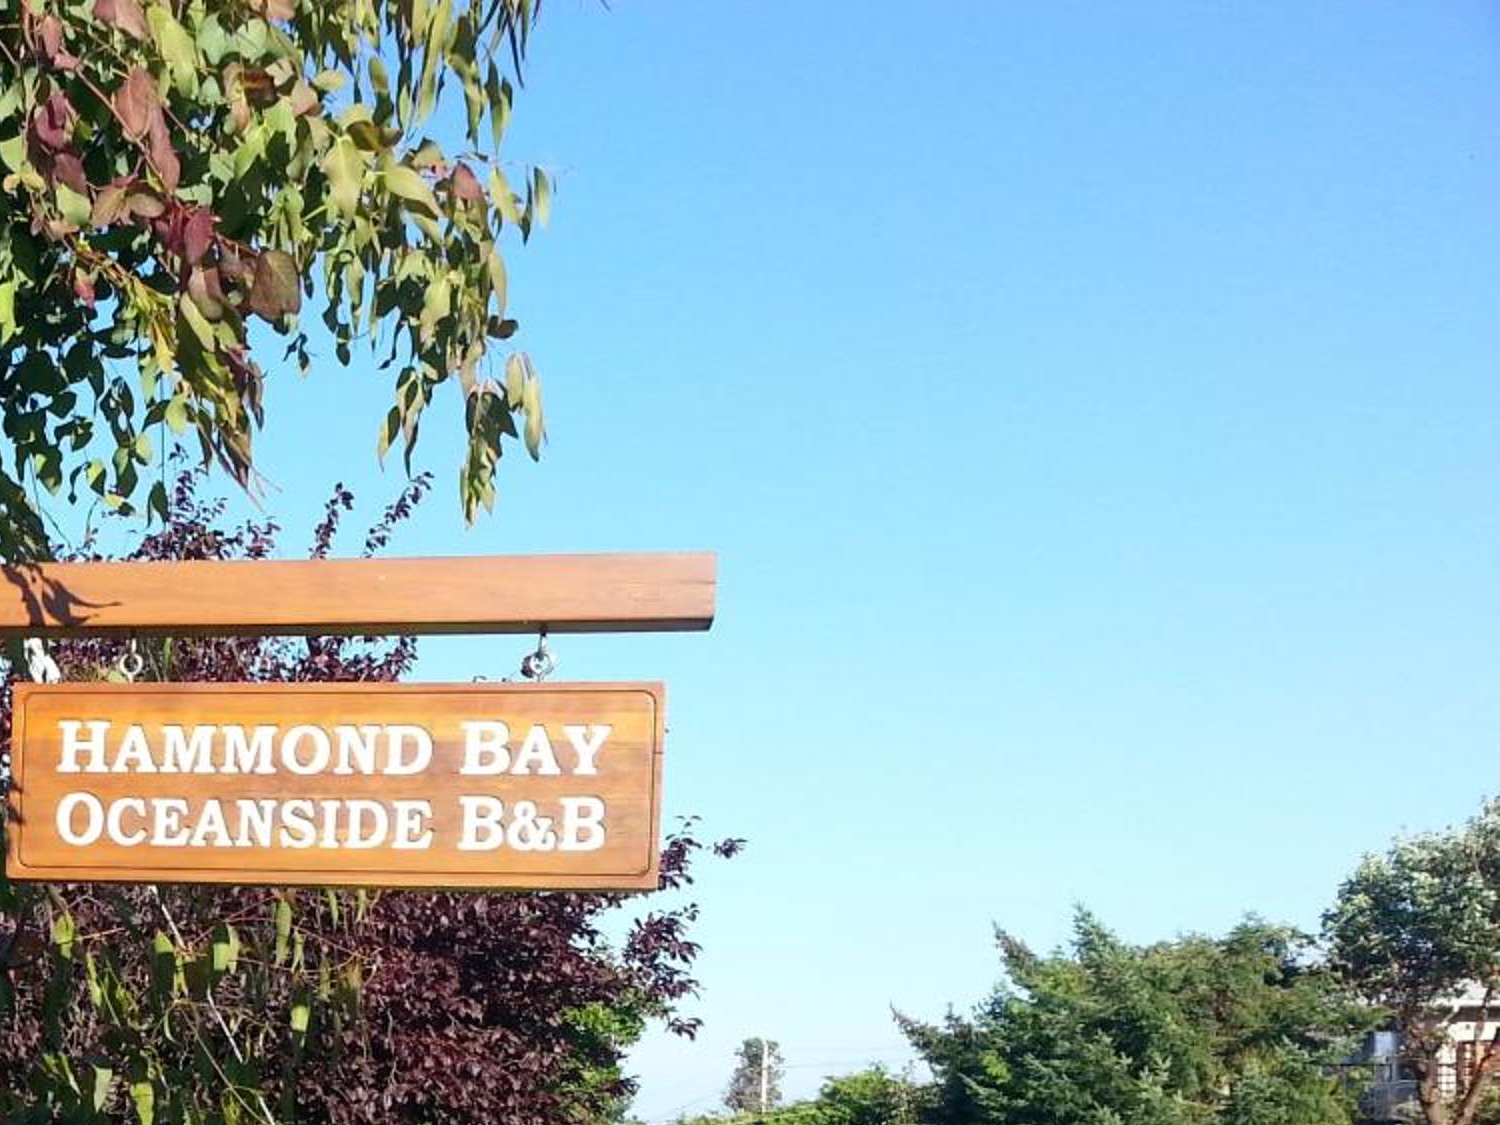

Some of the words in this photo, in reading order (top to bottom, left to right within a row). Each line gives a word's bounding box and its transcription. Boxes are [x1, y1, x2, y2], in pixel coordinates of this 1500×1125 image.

[56, 719, 433, 775] HAMMOND
[459, 719, 613, 776] BAY
[55, 792, 434, 849] OCEANSIDE
[457, 795, 607, 852] B&B
